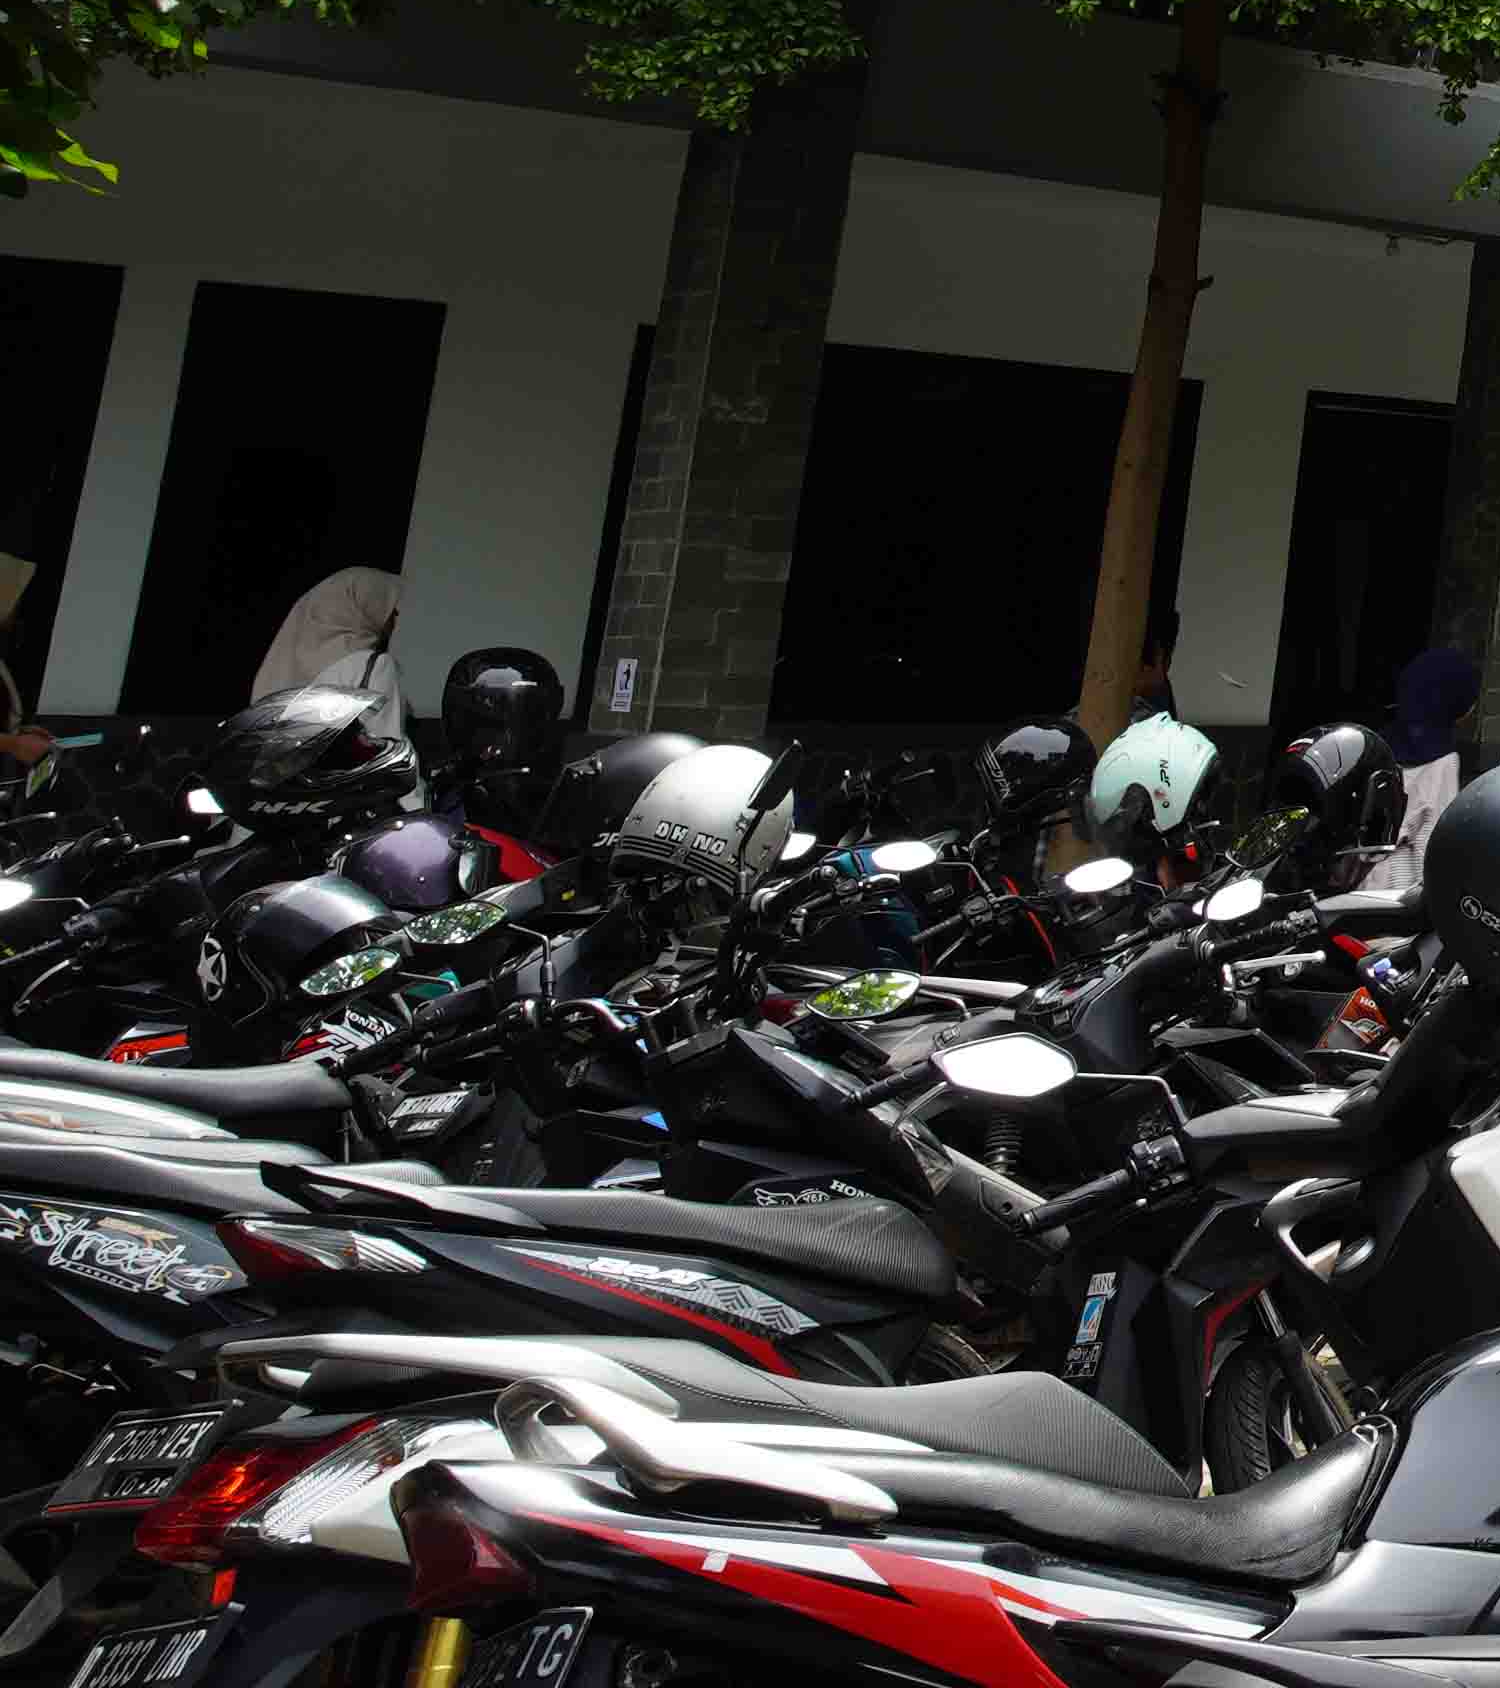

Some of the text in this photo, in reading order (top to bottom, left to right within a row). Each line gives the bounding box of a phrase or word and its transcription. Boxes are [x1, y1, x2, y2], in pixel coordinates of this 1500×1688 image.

[1158, 759, 1172, 788] JPN
[248, 799, 336, 816] NHK
[591, 831, 621, 848] JP
[655, 821, 728, 856] OH NO
[30, 1210, 187, 1291] Street
